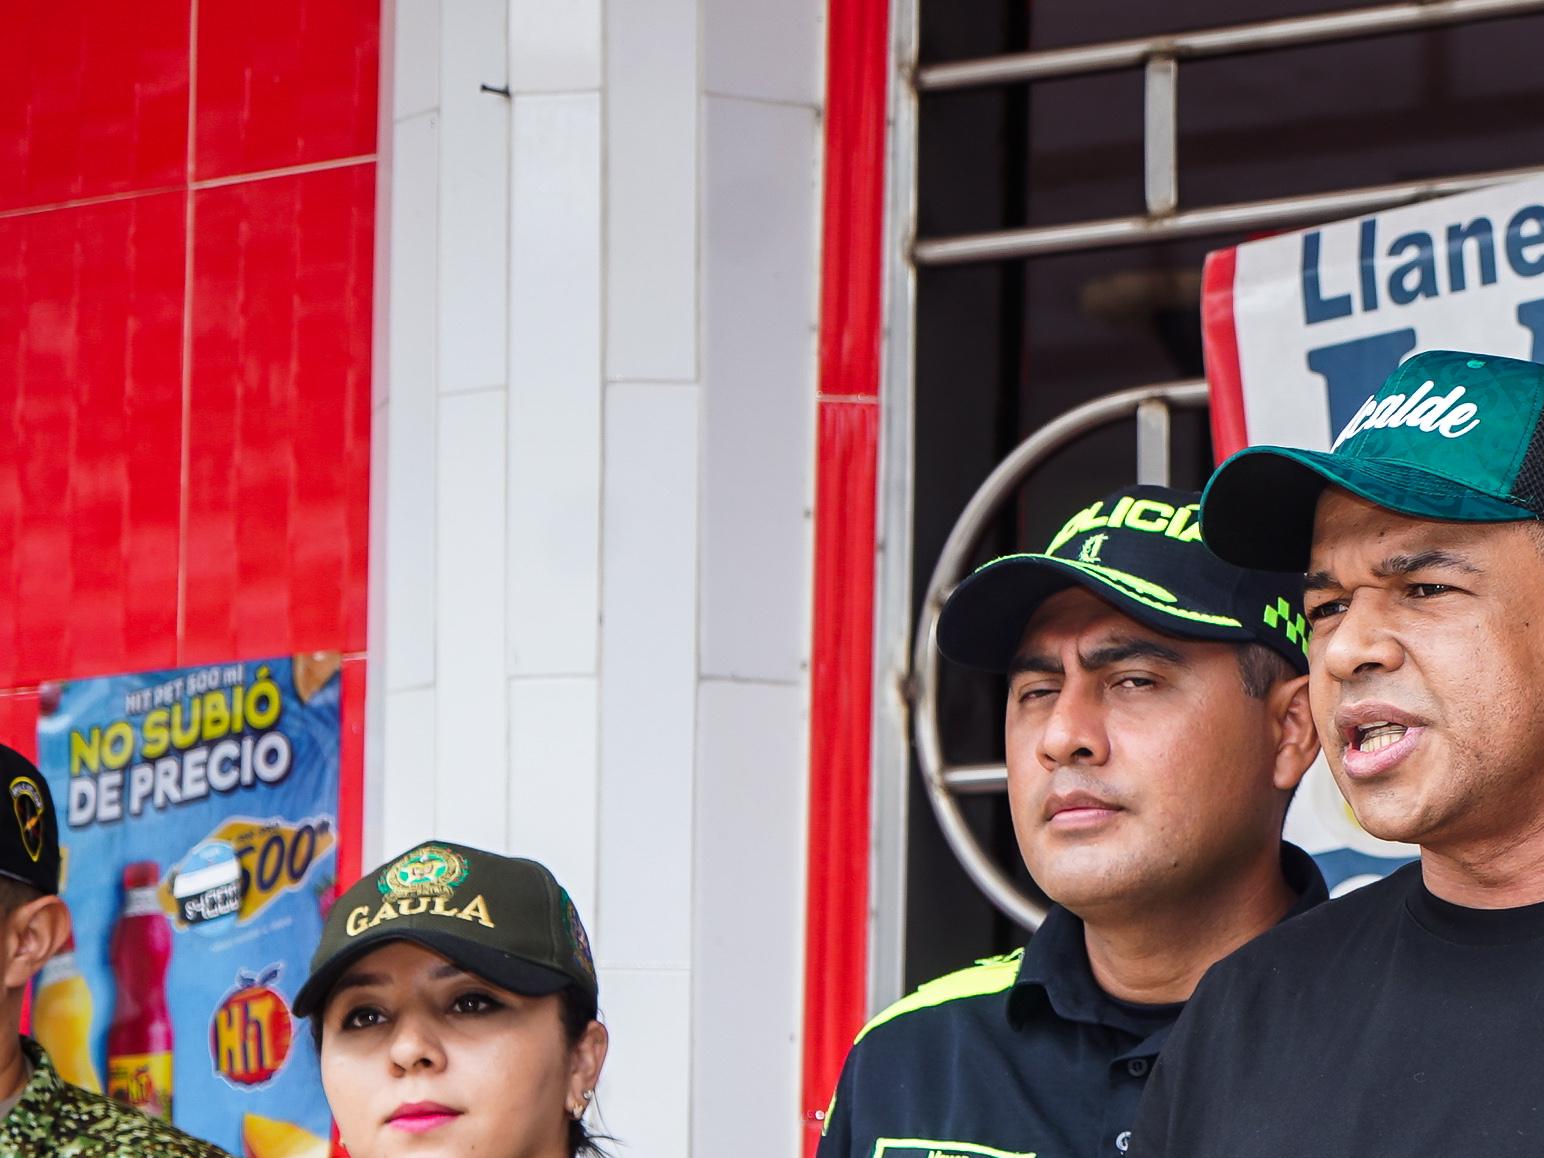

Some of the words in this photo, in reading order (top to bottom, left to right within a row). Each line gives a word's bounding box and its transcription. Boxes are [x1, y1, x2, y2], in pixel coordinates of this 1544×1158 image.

[70, 721, 134, 776] NO
[140, 665, 282, 760] SUBIÓ
[68, 769, 123, 827] DE
[128, 731, 292, 816] PRECIO
[345, 894, 496, 938] GAULA
